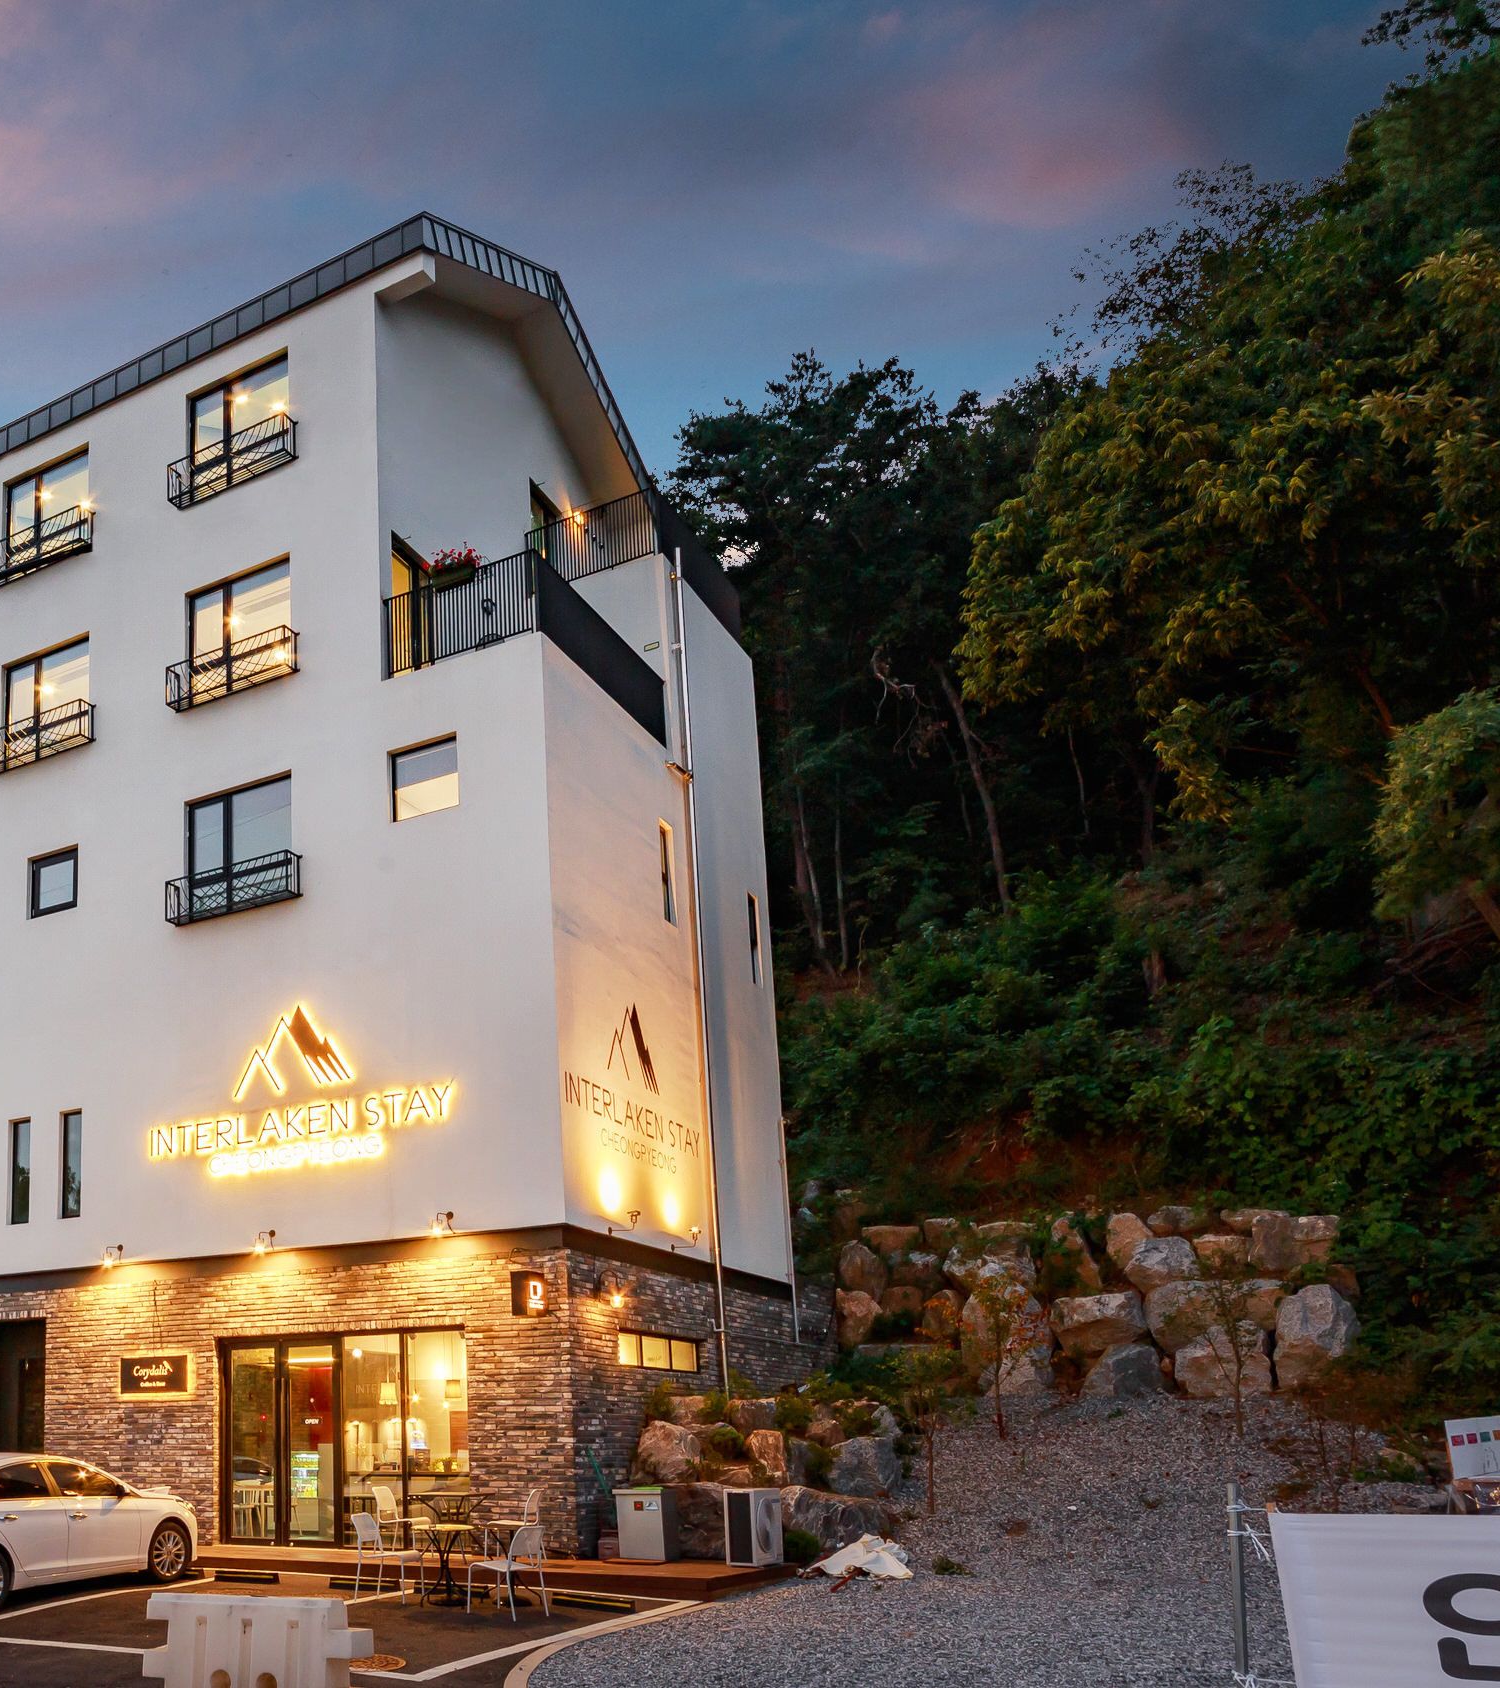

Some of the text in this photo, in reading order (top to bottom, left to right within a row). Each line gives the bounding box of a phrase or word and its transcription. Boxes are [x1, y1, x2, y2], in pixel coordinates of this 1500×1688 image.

[150, 1085, 450, 1157] INTERLAKEN STAY
[564, 1071, 700, 1158] INTERLAKEN STAY
[601, 1128, 677, 1174] CHEONGPYEONG
[133, 1364, 168, 1380] Corydalis
